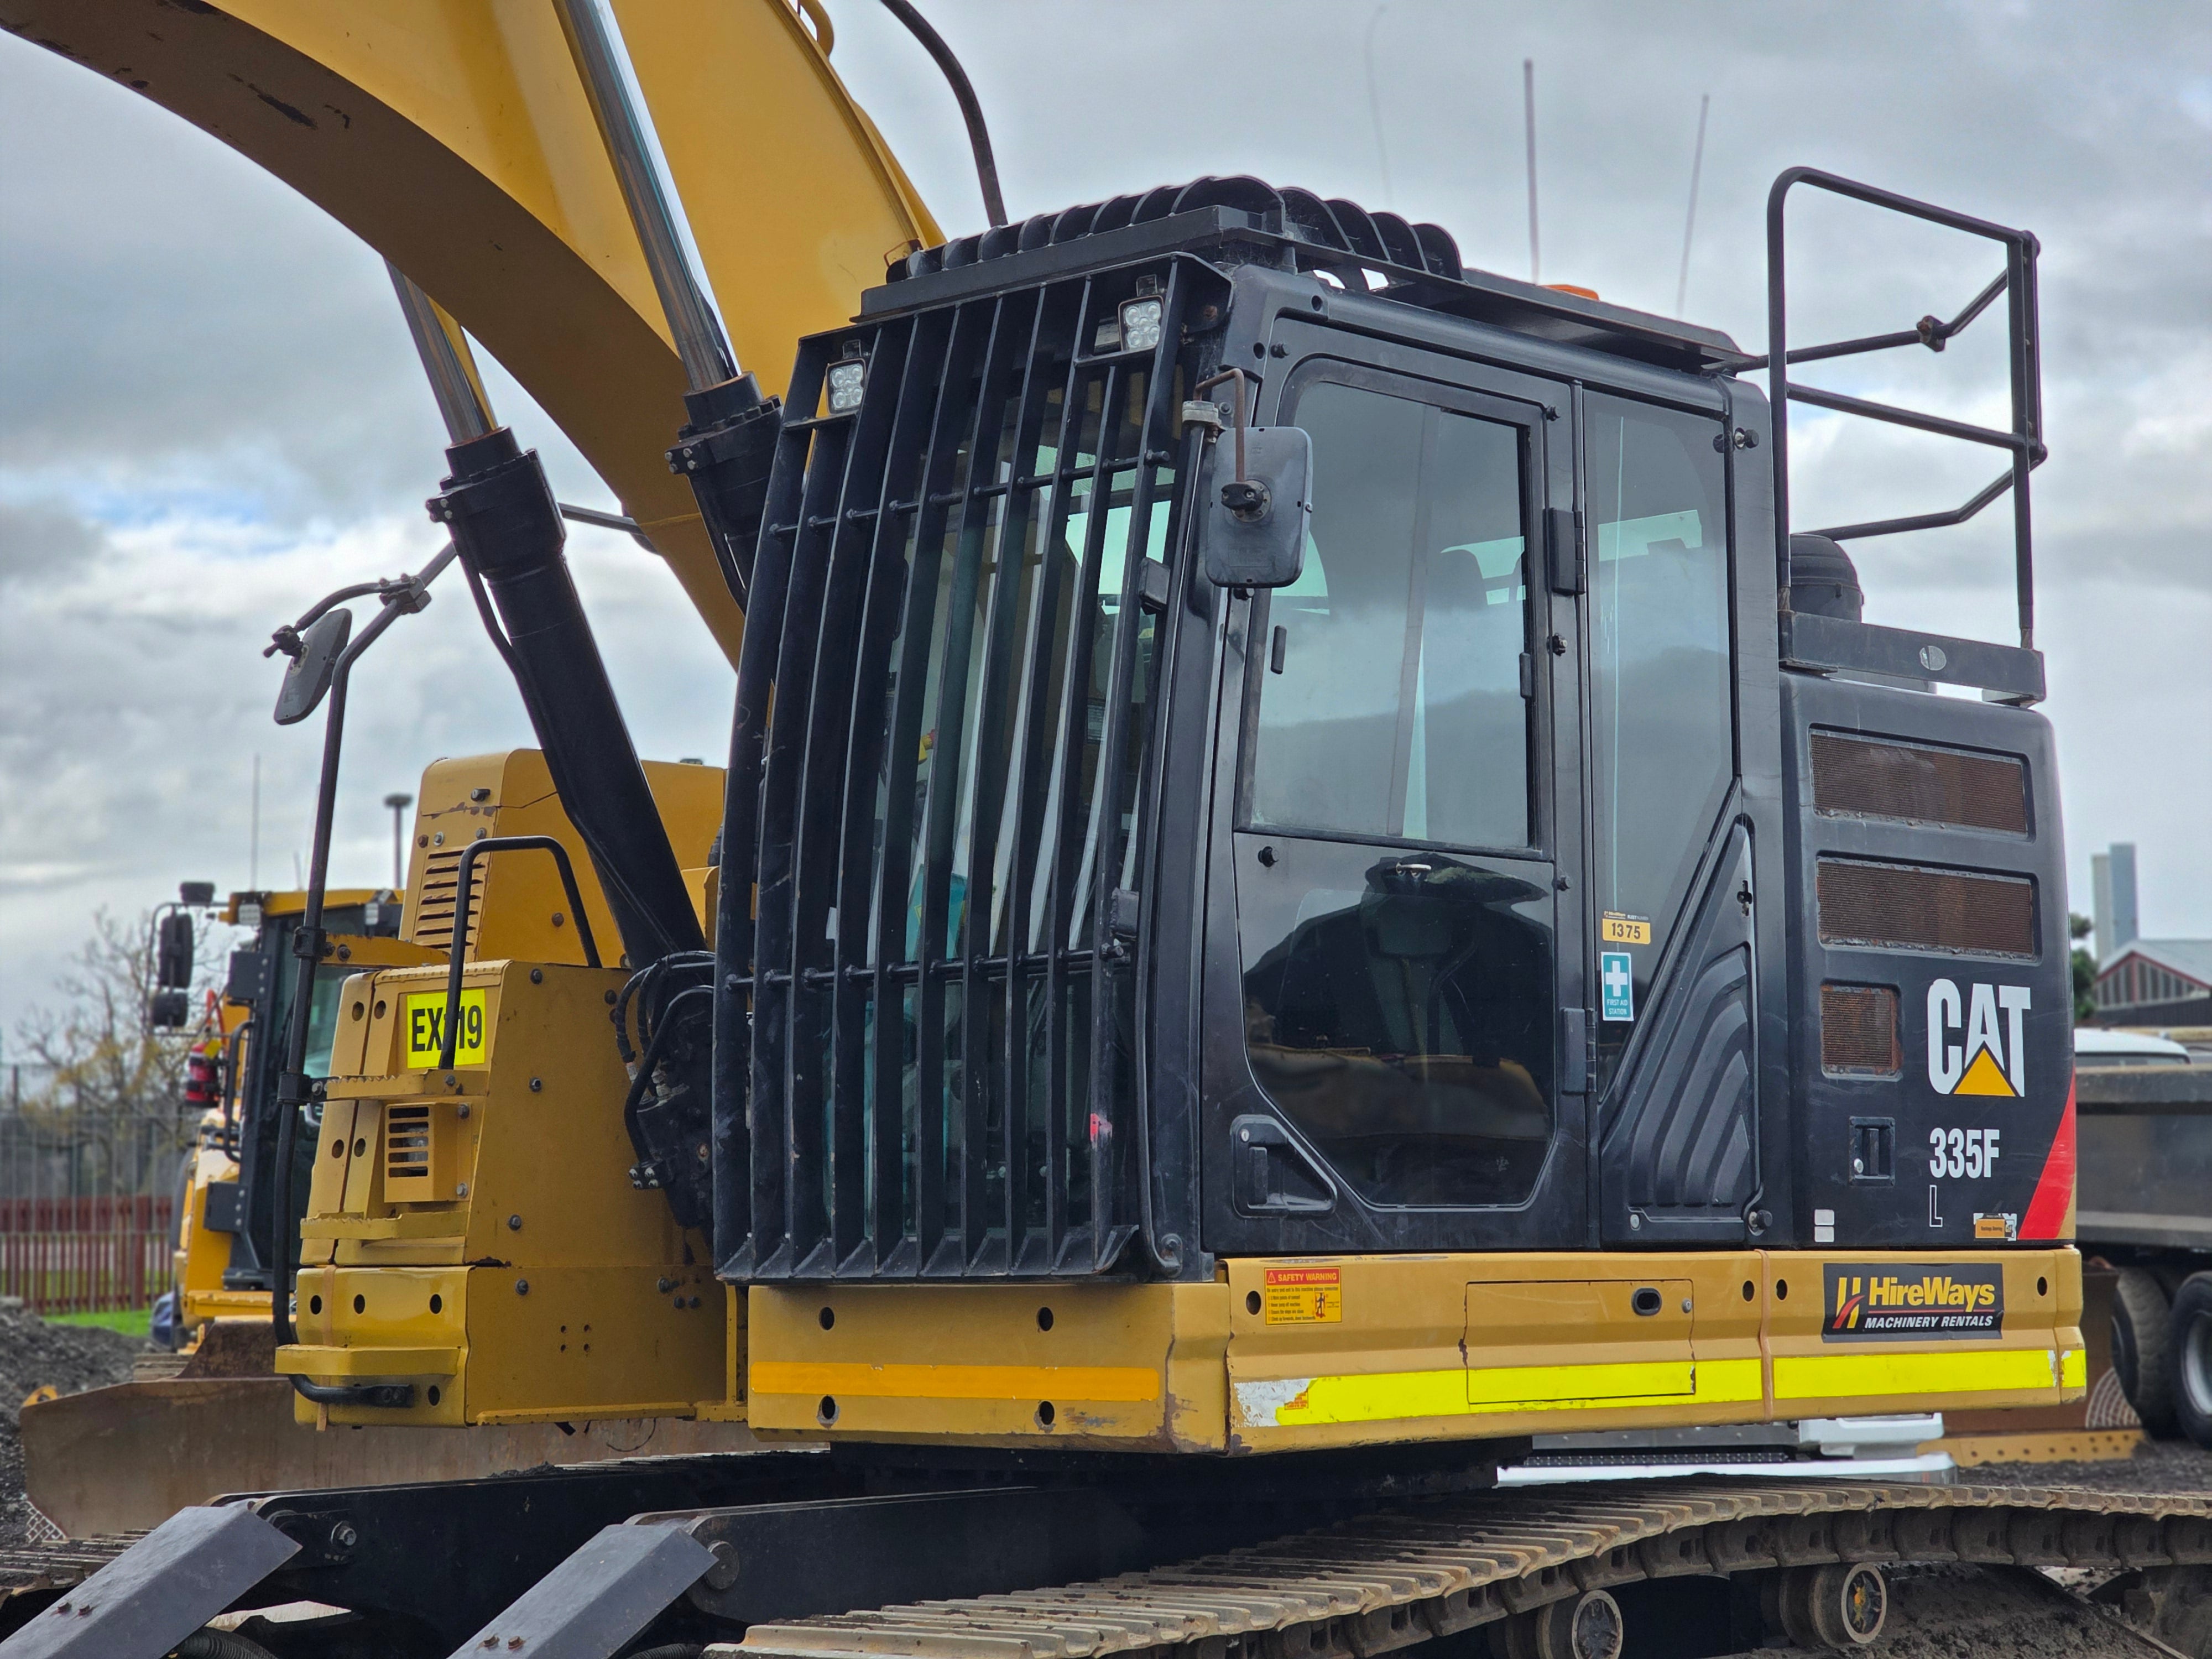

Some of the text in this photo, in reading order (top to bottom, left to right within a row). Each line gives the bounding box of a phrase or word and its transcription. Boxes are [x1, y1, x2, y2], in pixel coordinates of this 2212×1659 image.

[1611, 922, 1641, 940] 1375
[1927, 978, 2031, 1097] CAT
[1929, 1128, 2000, 1179] 335F
[1929, 1185, 1943, 1227] L
[1278, 1272, 1337, 1281] SAFETY WARNING
[1869, 1276, 1995, 1312] HireWays
[1865, 1316, 1993, 1328] MACHINERY RENTALS
